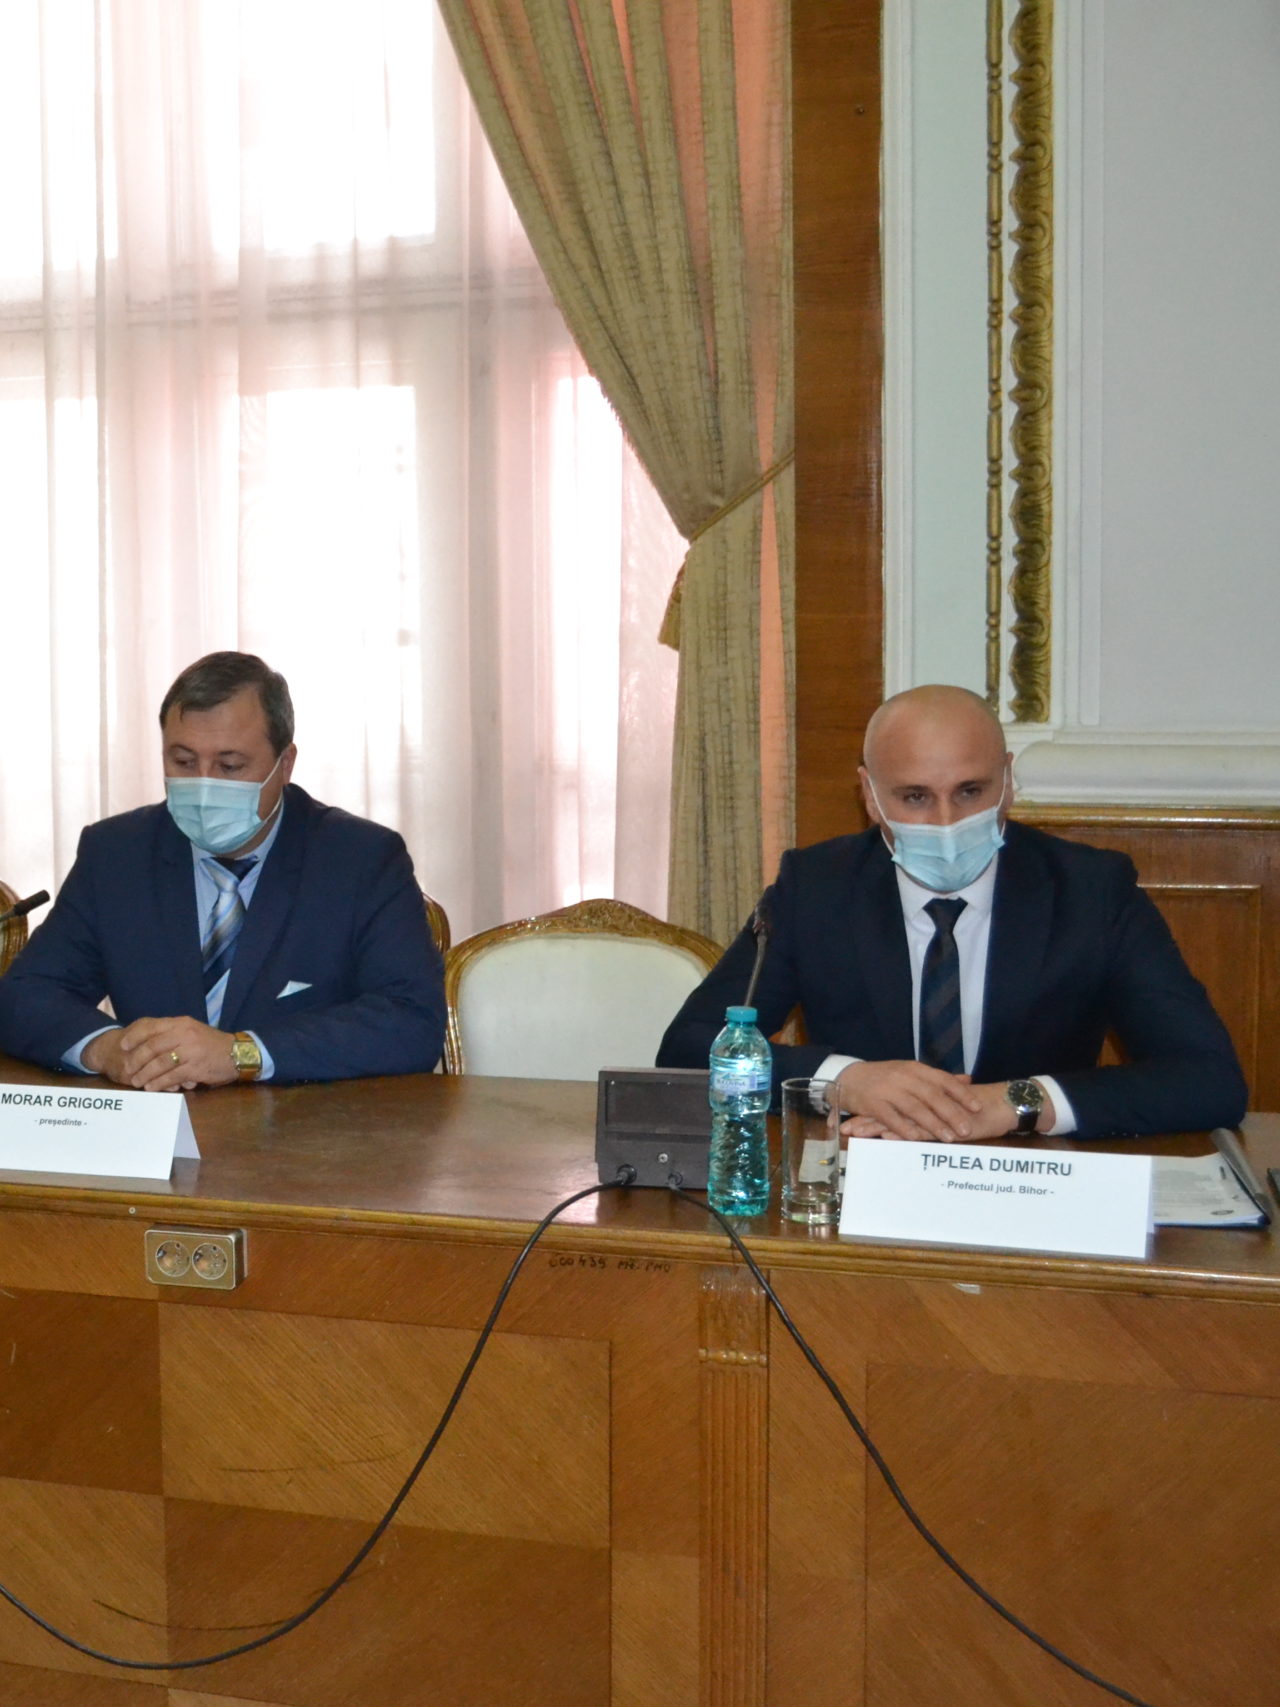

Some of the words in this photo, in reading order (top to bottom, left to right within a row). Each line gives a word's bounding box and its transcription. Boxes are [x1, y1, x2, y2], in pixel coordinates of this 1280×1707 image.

[1, 1093, 54, 1108] MORAR
[57, 1096, 124, 1111] GRIGORE
[989, 1158, 1072, 1176] DUMITRU
[947, 1180, 994, 1192] Prefectul
[995, 1183, 1016, 1194] jud.
[1019, 1185, 1048, 1196] Bihor
